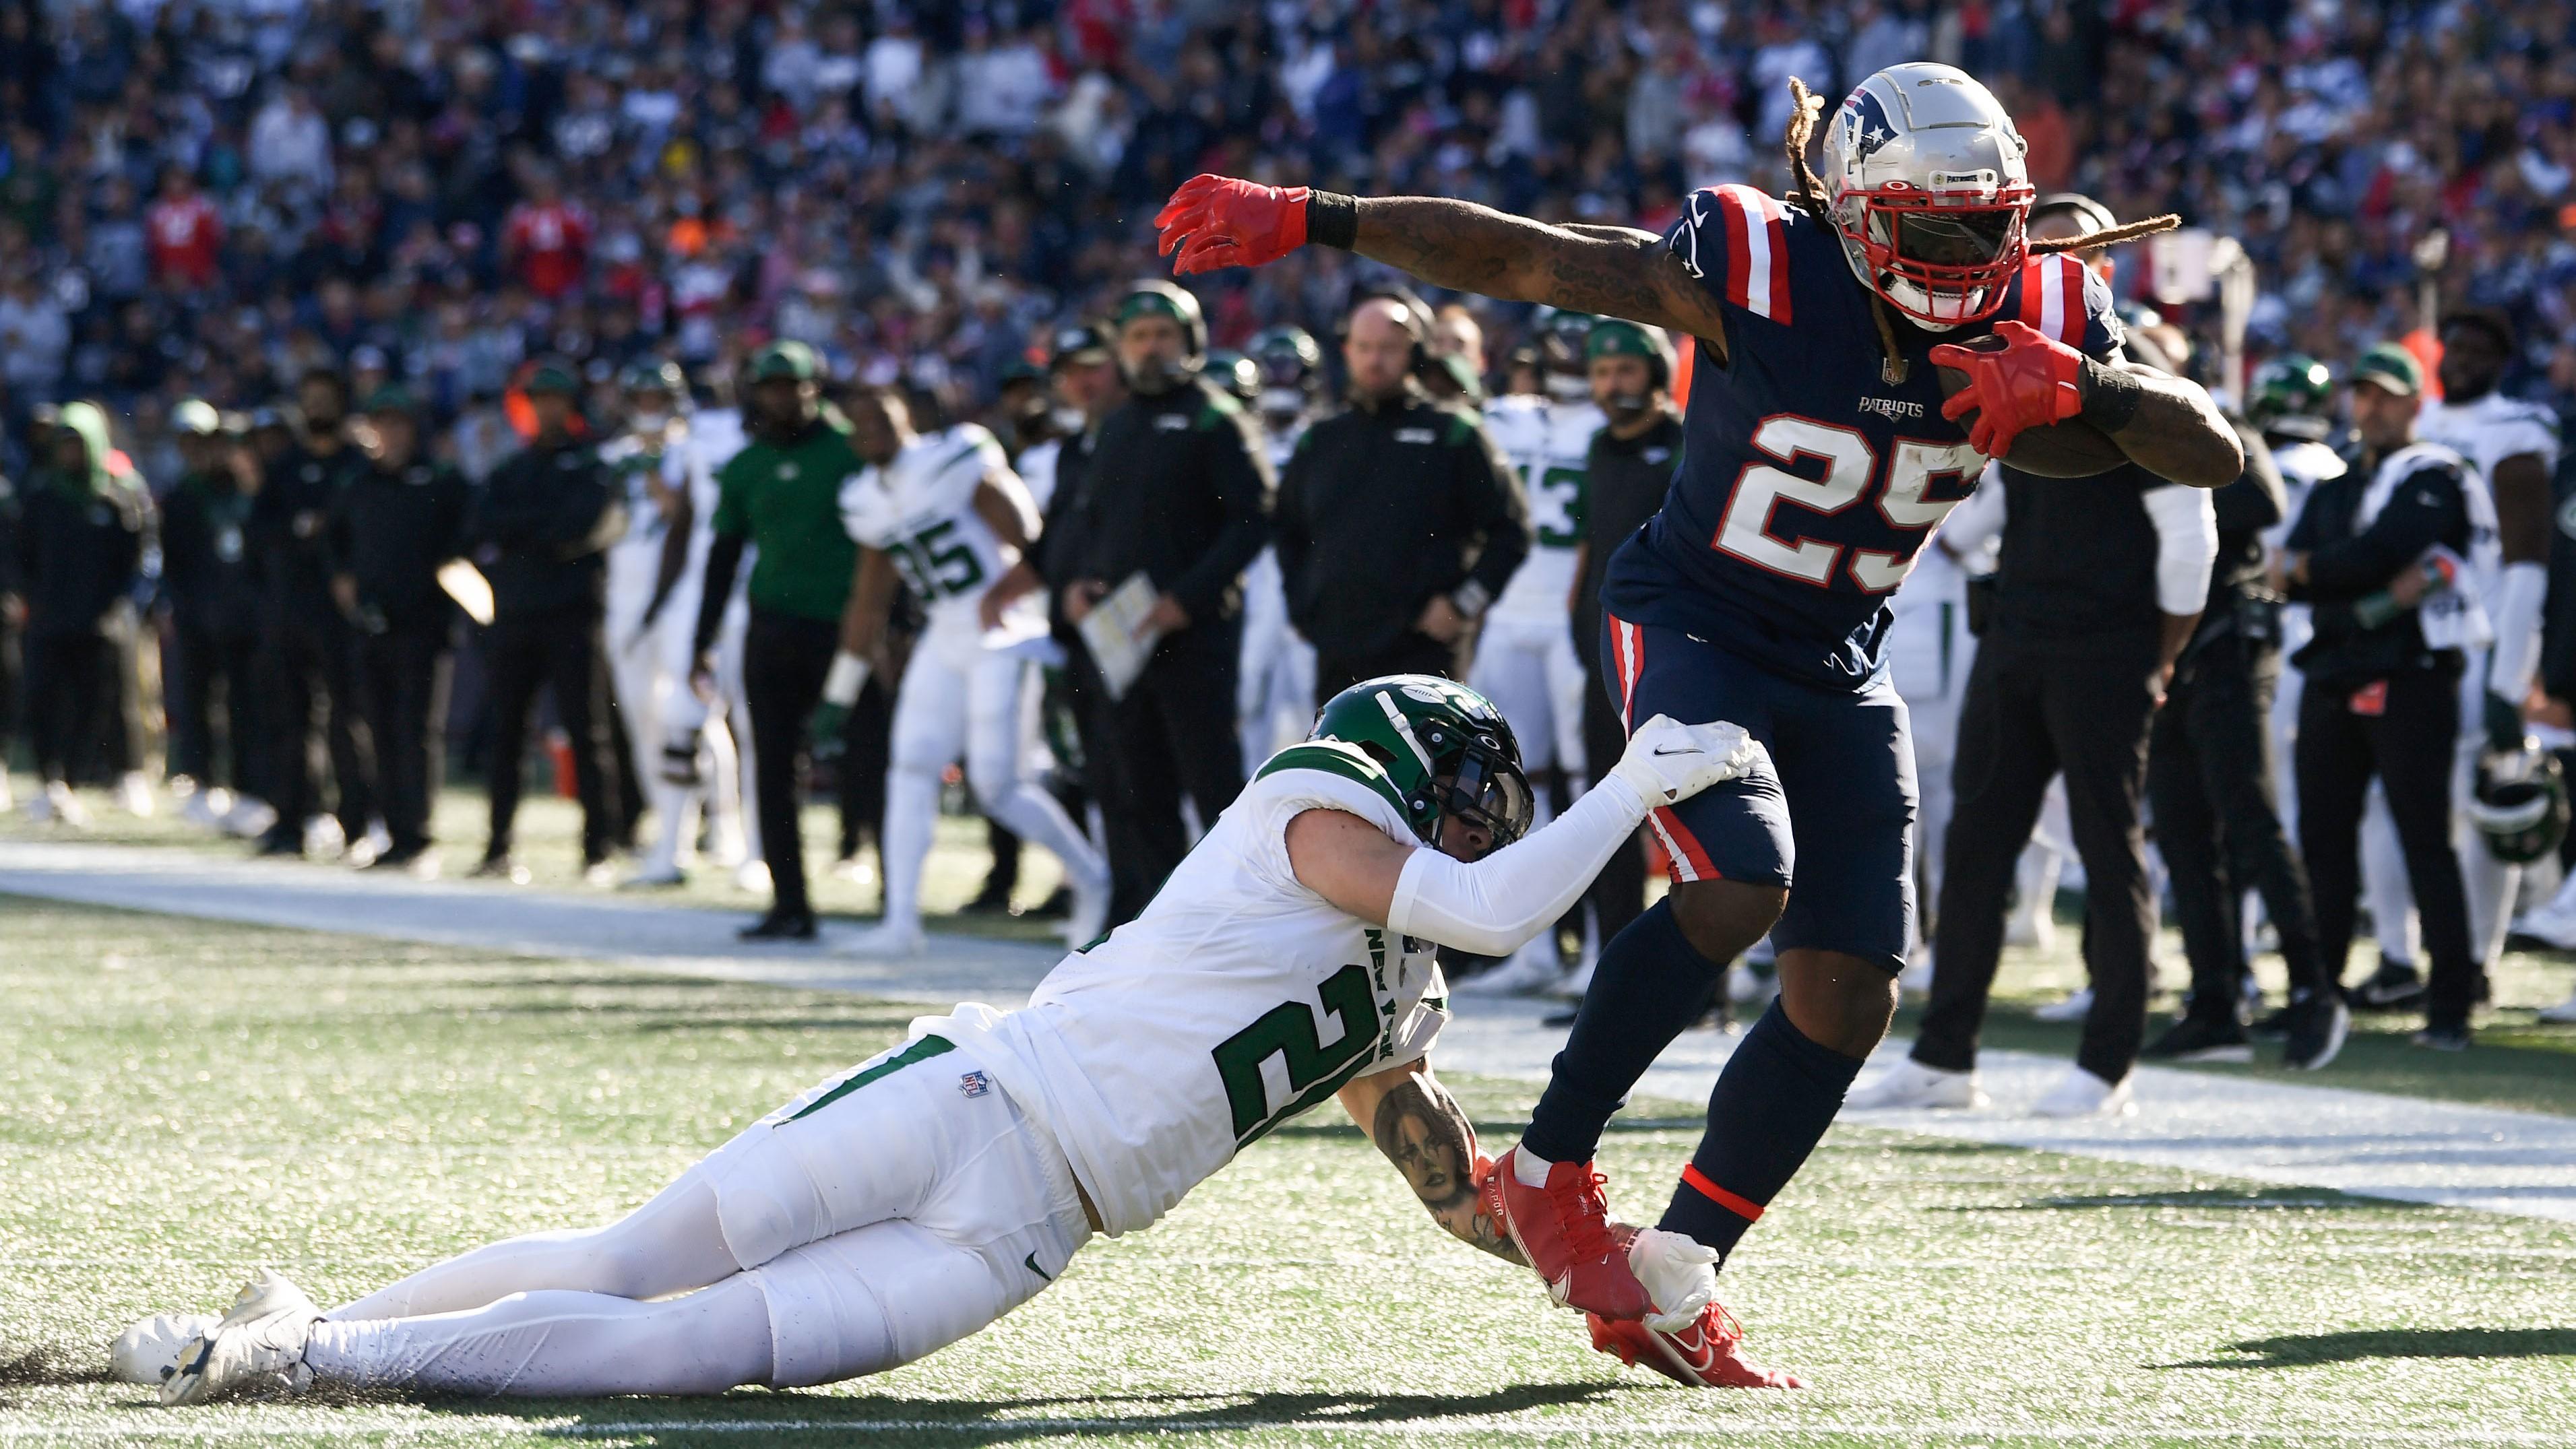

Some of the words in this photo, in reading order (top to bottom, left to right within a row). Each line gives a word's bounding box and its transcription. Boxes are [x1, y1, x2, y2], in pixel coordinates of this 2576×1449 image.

[1858, 396, 1924, 418] PATRIOTS
[1517, 465, 1590, 548] 3
[1711, 413, 1988, 594] 25
[1364, 928, 1388, 992] NEW
[1211, 964, 1381, 1161] 2
